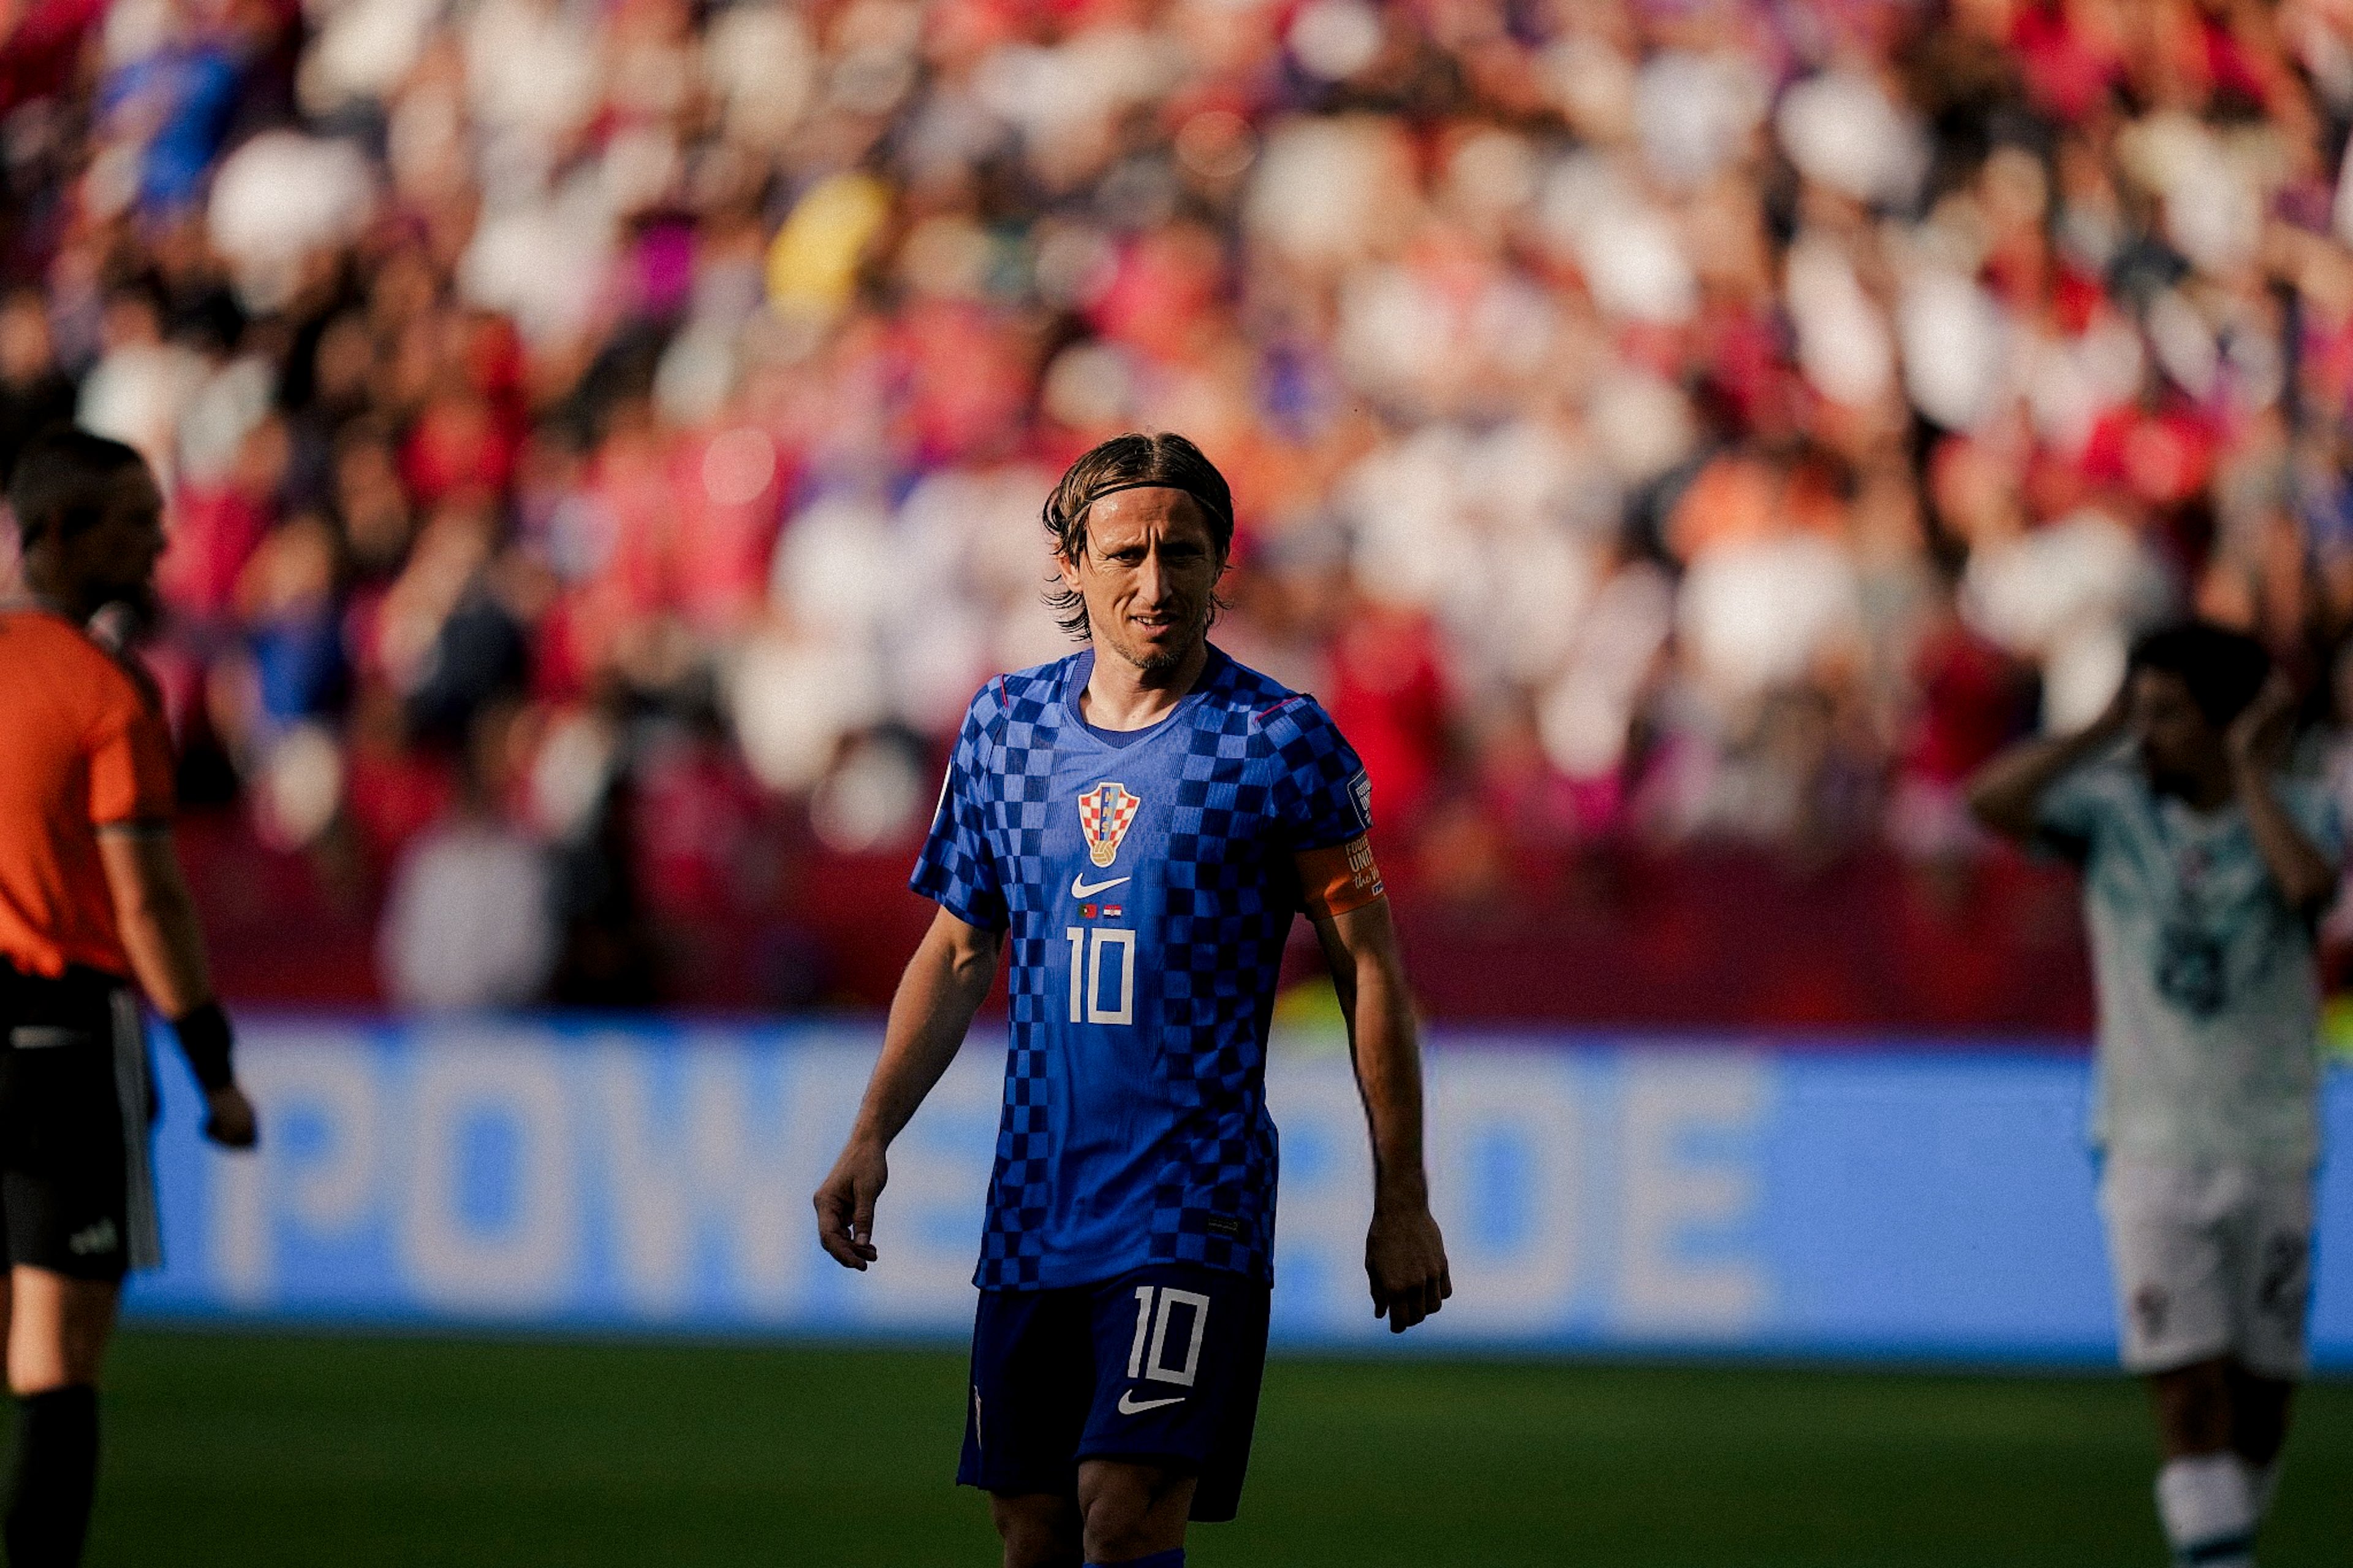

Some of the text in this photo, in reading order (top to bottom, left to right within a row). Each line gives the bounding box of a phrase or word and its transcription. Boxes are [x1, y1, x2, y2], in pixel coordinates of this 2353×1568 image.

[1101, 791, 1114, 832] HNS
[1067, 926, 1135, 1025] 10
[205, 1036, 1774, 1333] POWEADE
[1127, 1286, 1210, 1387] 10
